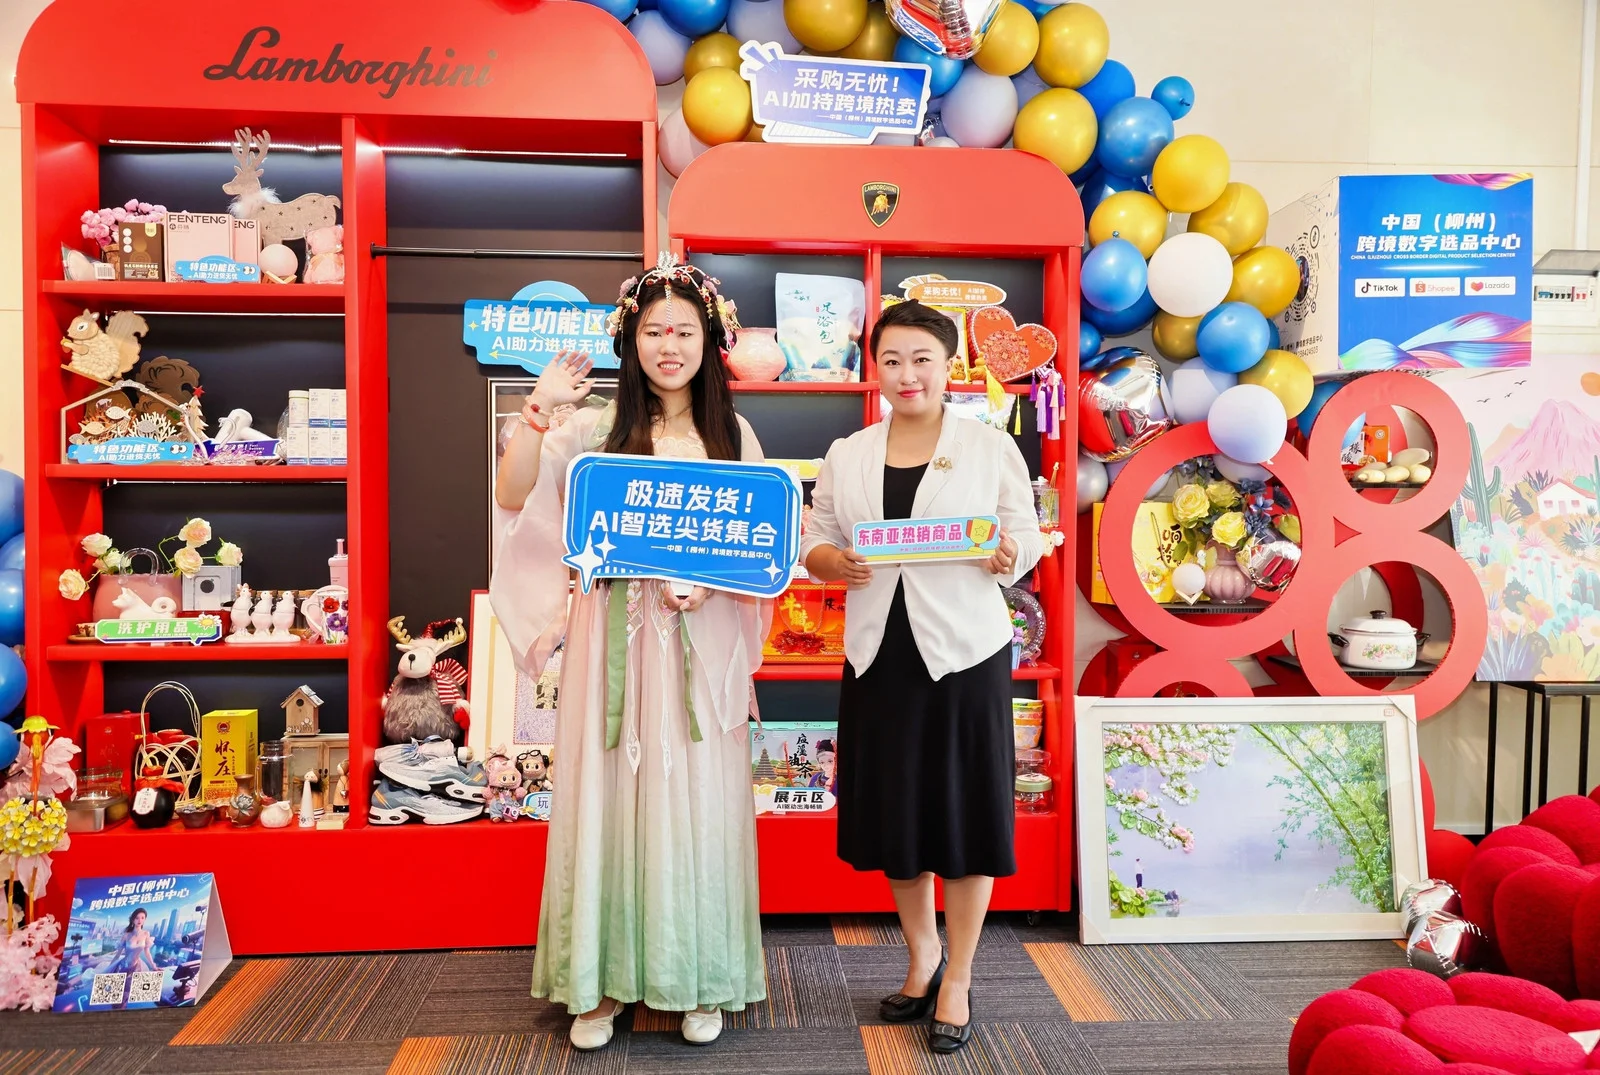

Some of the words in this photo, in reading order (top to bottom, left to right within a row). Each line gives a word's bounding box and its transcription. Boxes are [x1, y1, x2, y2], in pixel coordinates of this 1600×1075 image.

[203, 26, 498, 99] Lamborghini
[793, 68, 899, 94] 采购无忧！
[763, 90, 917, 117] AI加持跨境热卖
[168, 214, 227, 224] FENTENG
[1356, 233, 1521, 253] 跨境数字选品中心
[189, 262, 238, 273] 特色功能区
[1373, 284, 1399, 292] TikTok
[1427, 284, 1455, 293] Shopee
[1485, 282, 1510, 290] Lazada
[481, 304, 606, 336] 特色功能区
[817, 302, 837, 344] 足浴包
[492, 336, 610, 355] AI助力进货无忧
[92, 443, 160, 454] 特色功能区
[624, 479, 753, 515] 极速发货！
[589, 510, 777, 547] AI智选尖货集合
[857, 523, 963, 546] 东南亚热销商品
[118, 621, 188, 634] 洗护用品
[774, 791, 825, 804] 展示区
[89, 888, 190, 911] 跨境数字选品中心
